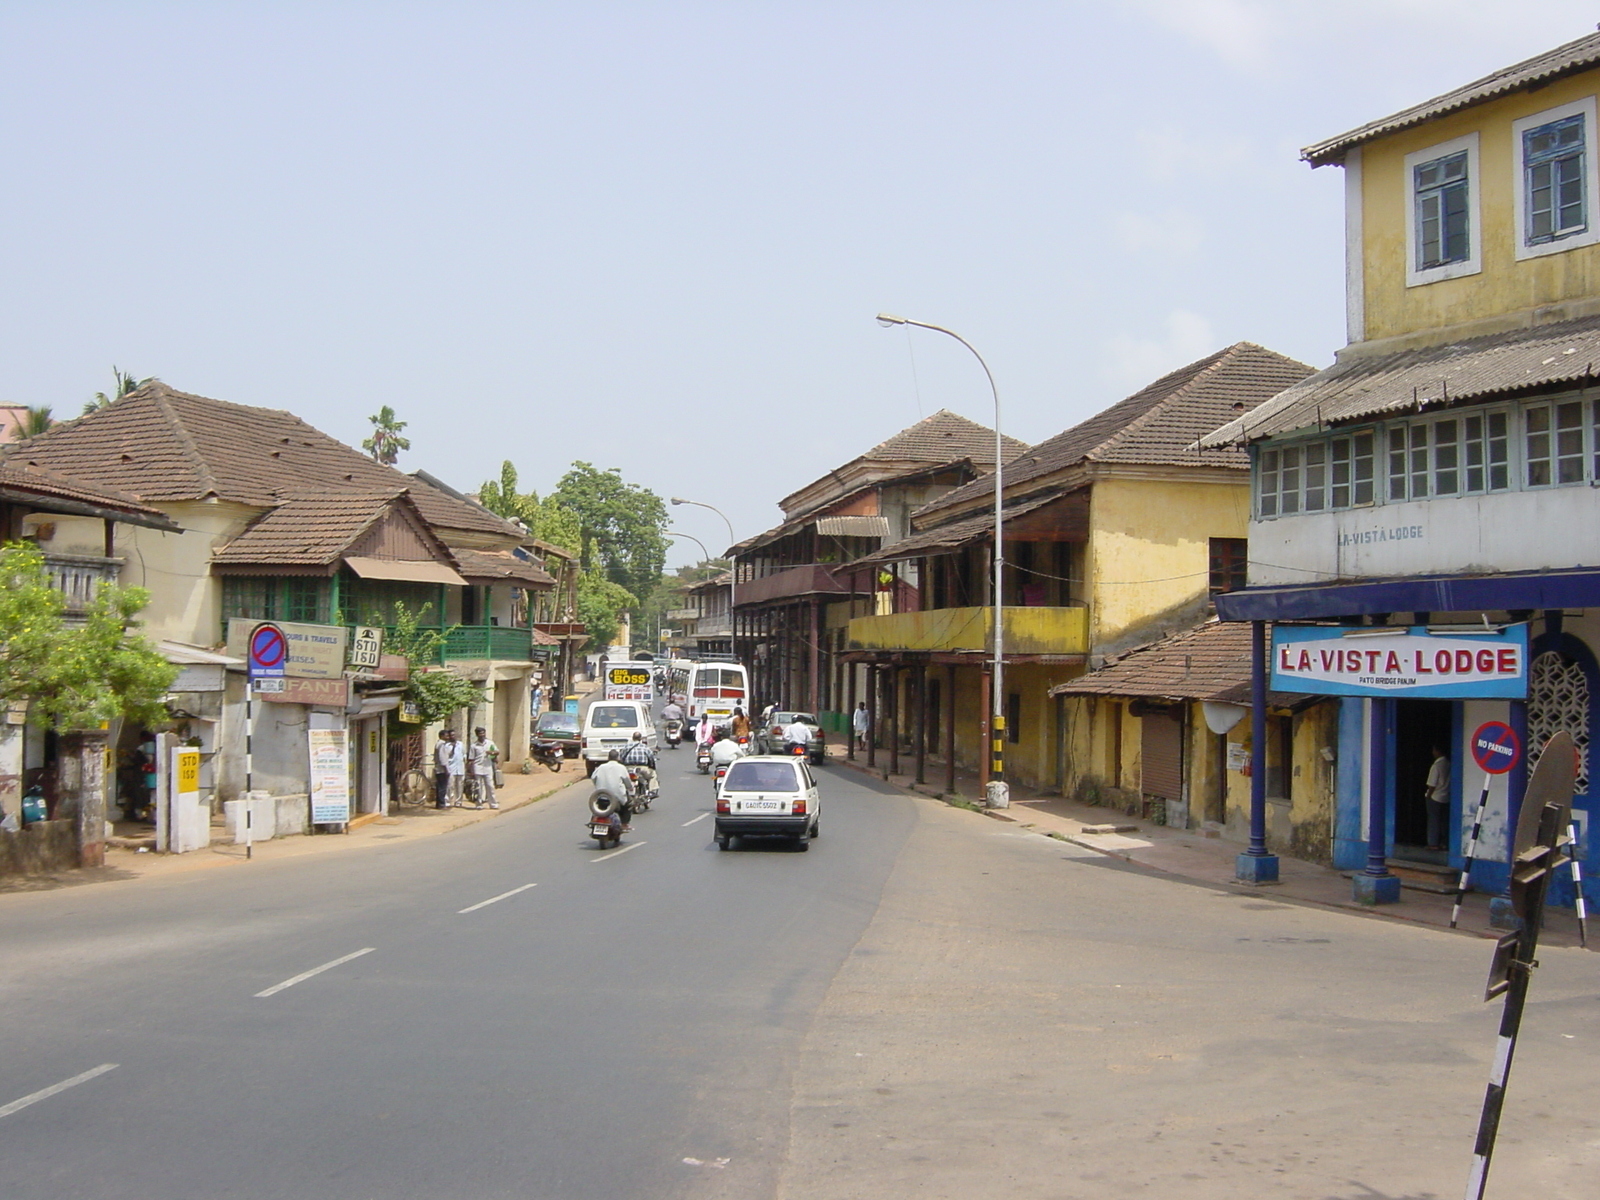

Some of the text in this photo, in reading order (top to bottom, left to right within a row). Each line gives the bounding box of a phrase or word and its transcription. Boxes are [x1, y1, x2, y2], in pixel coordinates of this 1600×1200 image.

[1389, 525, 1423, 541] LODGE
[286, 633, 302, 641] OURS
[311, 635, 337, 645] TRAVELS
[356, 639, 377, 652] STD
[354, 652, 376, 665] ISD
[614, 674, 646, 684] BOSS
[1375, 677, 1396, 685] BRIDGE
[1477, 739, 1513, 756] NO PARKING
[182, 756, 197, 766] STD
[183, 769, 195, 780] ISD
